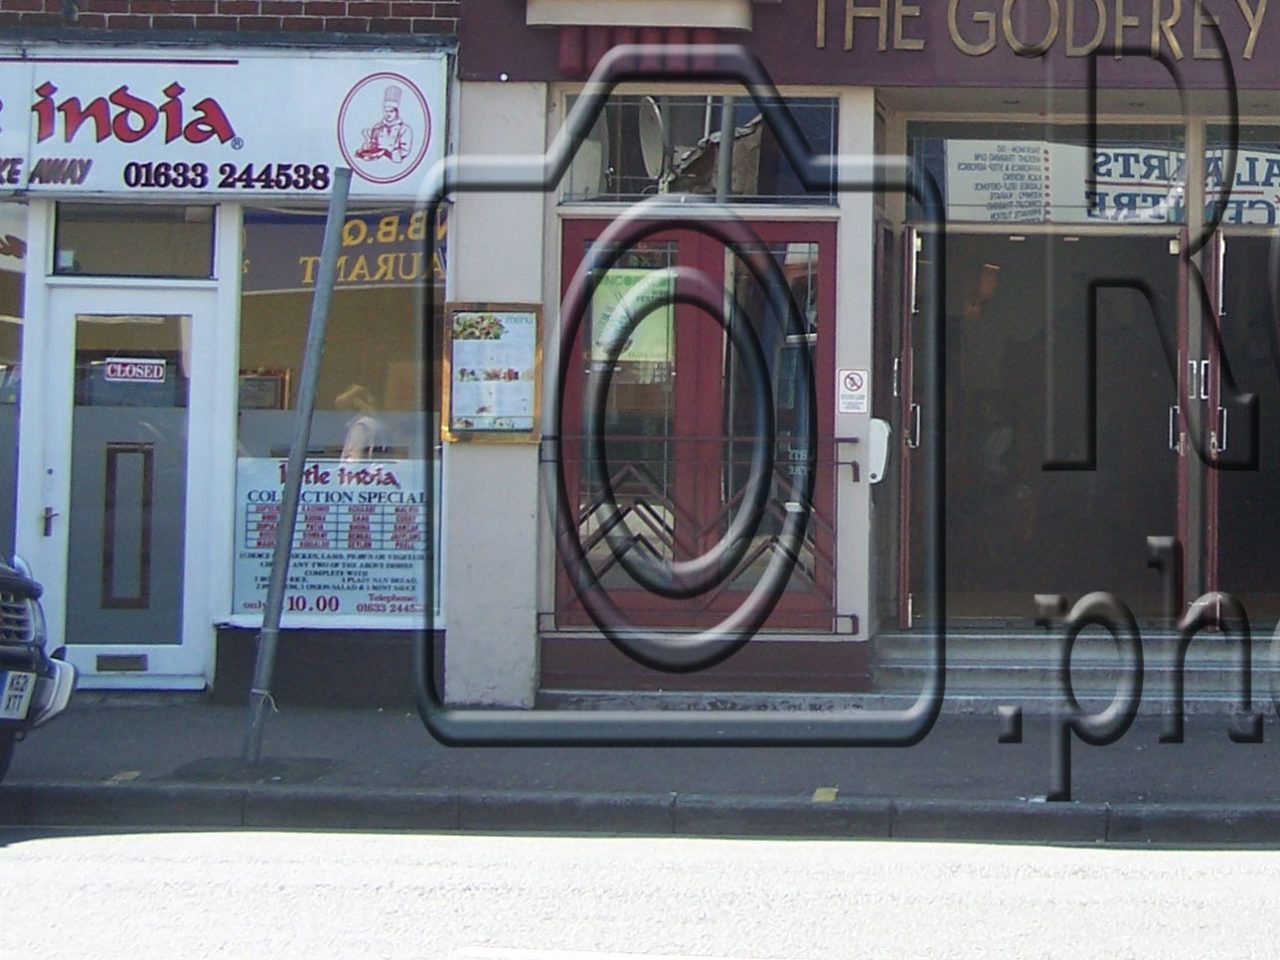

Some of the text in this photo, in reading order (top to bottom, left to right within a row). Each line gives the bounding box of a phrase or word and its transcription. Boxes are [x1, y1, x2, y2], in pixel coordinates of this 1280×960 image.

[31, 81, 236, 144] india
[29, 158, 93, 185] AWAY
[123, 162, 330, 190] 01633 244538
[107, 363, 164, 378] CLOSED
[279, 464, 399, 486] ltle india
[248, 489, 354, 504] COLCTION
[281, 596, 340, 613] 10.00
